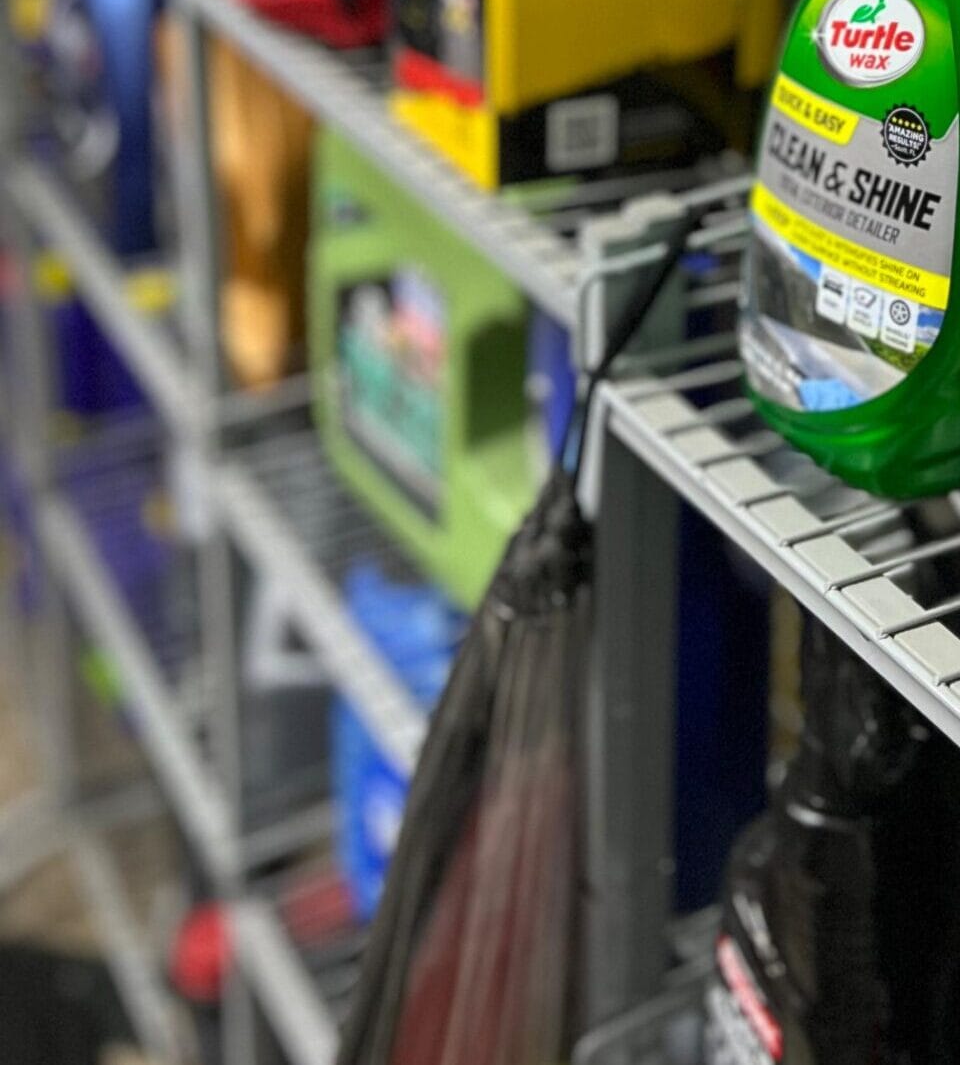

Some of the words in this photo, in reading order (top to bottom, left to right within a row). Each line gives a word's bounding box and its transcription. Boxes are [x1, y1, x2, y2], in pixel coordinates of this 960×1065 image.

[831, 21, 915, 52] Turtle
[850, 54, 890, 70] wax
[814, 107, 846, 134] EASY
[768, 121, 826, 184] CLEAN
[823, 160, 848, 196] &
[849, 169, 942, 231] SHINE
[845, 212, 901, 245] DETAILER
[878, 271, 926, 298] STREAKING
